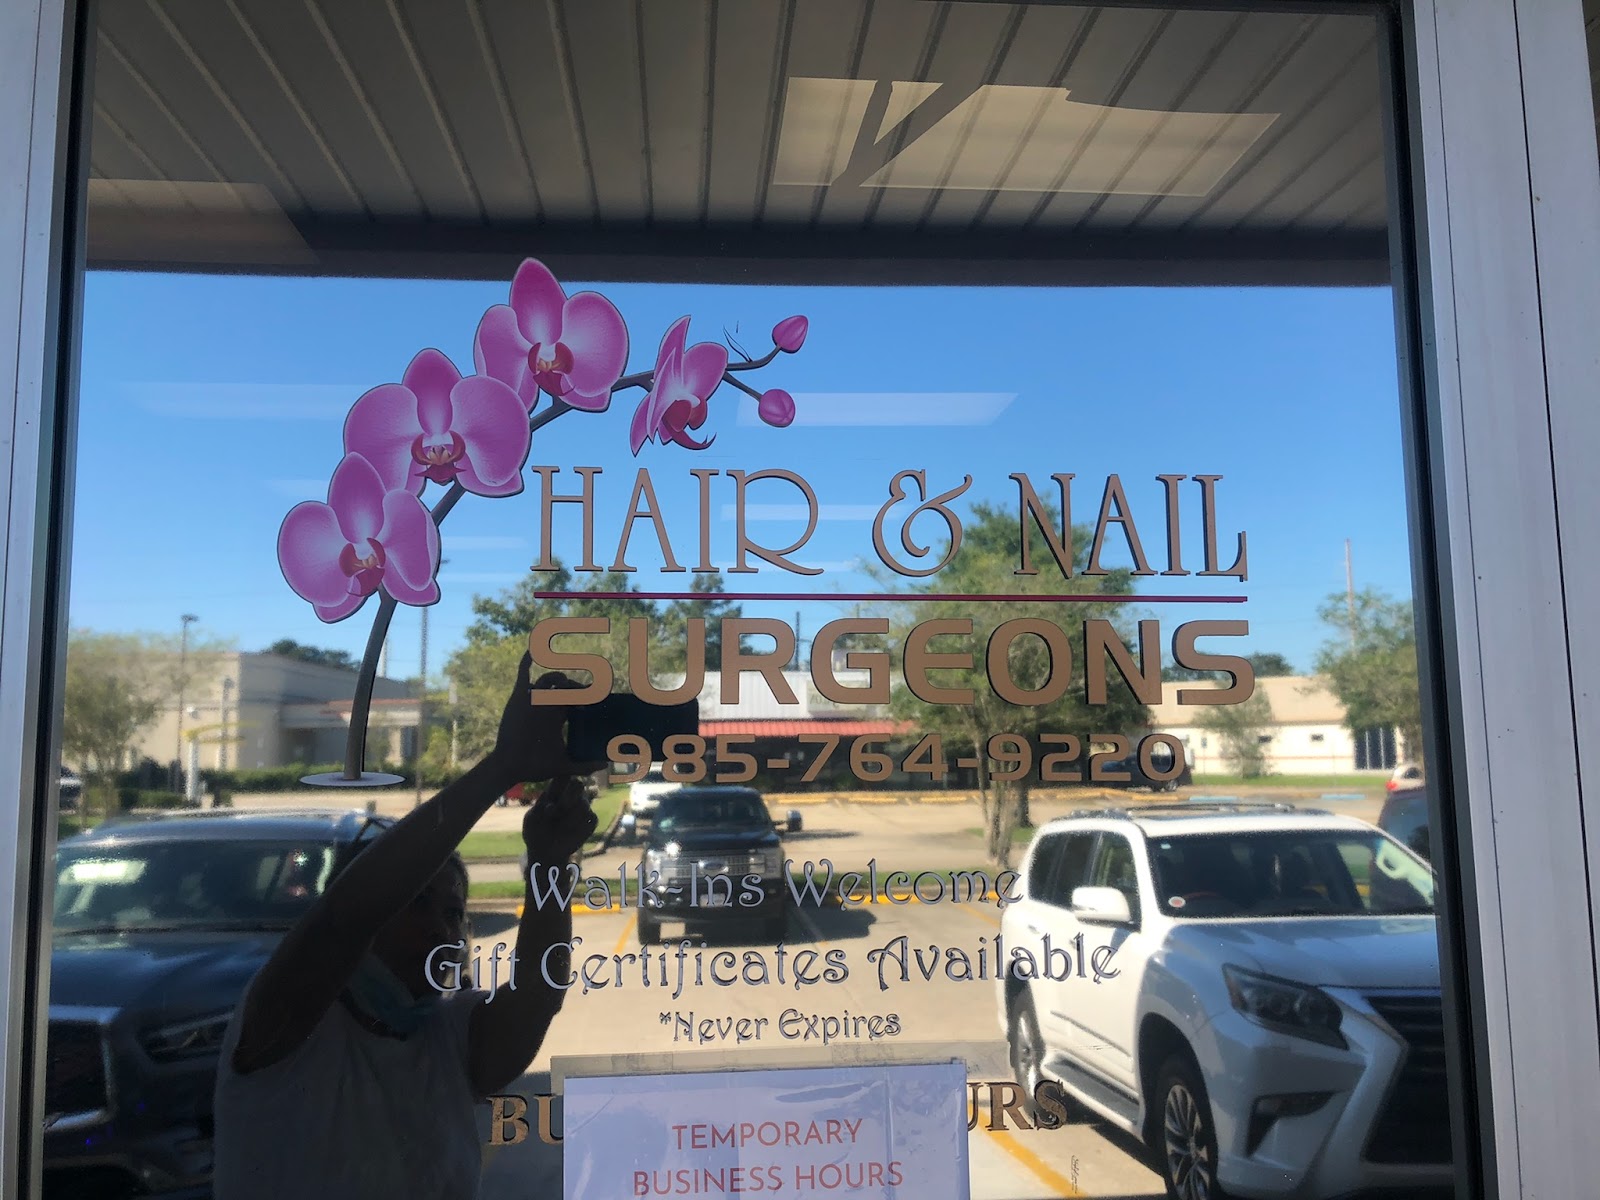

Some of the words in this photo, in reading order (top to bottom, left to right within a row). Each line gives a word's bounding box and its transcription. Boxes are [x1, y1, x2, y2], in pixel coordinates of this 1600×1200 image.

[530, 466, 825, 576] HAIR
[872, 469, 973, 577] &
[1009, 473, 1248, 583] NAIL
[528, 616, 1255, 706] SURGEONS
[606, 732, 1185, 784] 985-764-9220
[529, 861, 765, 912] Walk-Ins
[784, 858, 1024, 911] Welcome
[424, 940, 520, 1004] Gift
[540, 936, 849, 1000] Certificates
[867, 932, 1122, 992] Available
[778, 1008, 902, 1046] Expires
[672, 1118, 863, 1151] TEMPORARY
[633, 1165, 784, 1196] BUSINESS
[795, 1161, 904, 1190] HOURS
